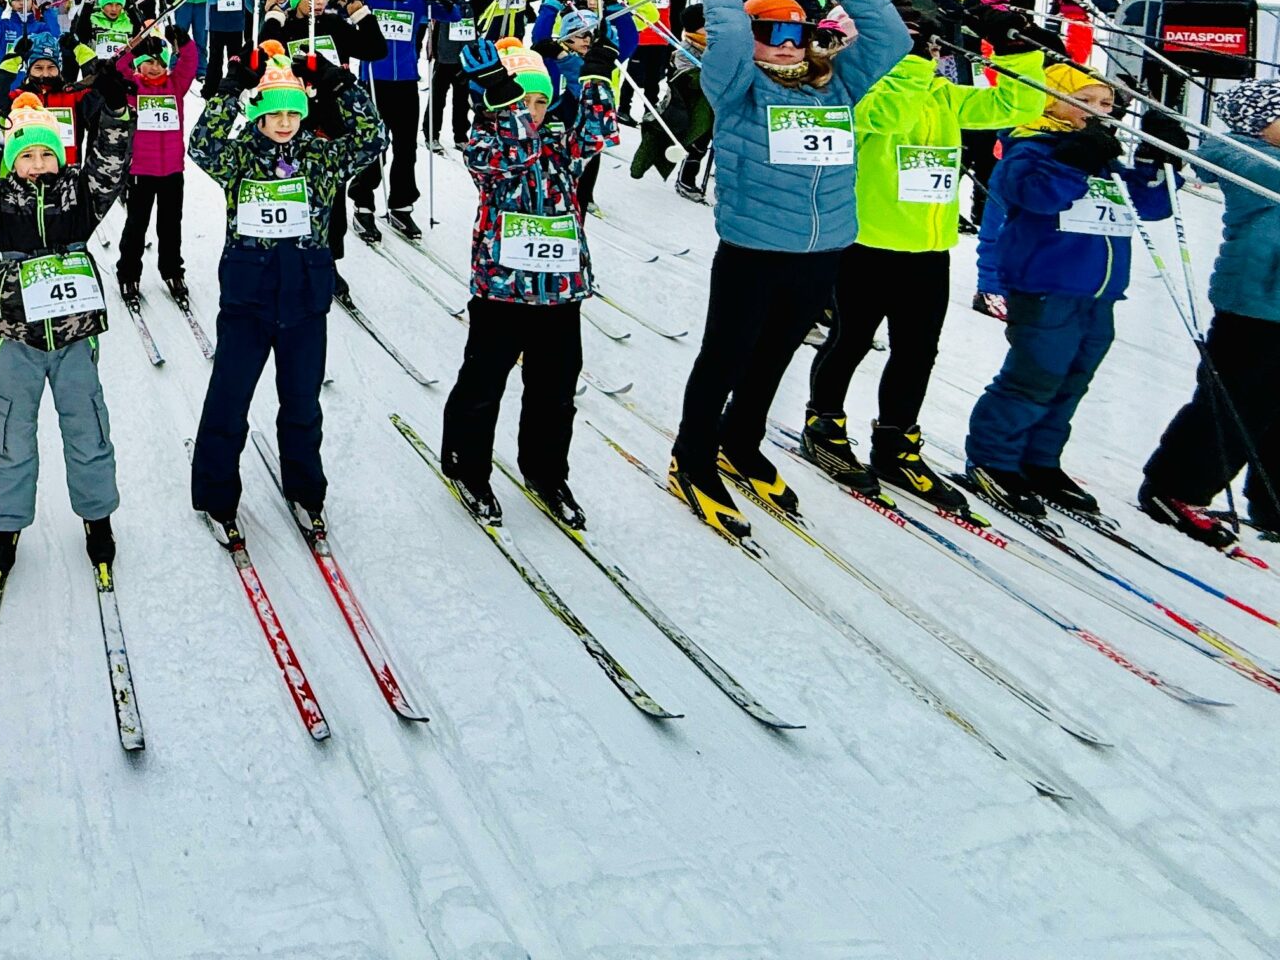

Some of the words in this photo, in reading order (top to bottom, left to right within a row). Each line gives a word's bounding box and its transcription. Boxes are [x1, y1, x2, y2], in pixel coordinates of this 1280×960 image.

[383, 24, 404, 33] 114
[1165, 31, 1244, 43] DATASPORT
[154, 112, 169, 122] 16
[803, 134, 833, 152] 31
[930, 173, 952, 189] 76
[261, 208, 288, 225] 50
[523, 242, 565, 259] 129
[50, 281, 78, 301] 45
[849, 489, 908, 529] SPORTEN
[1034, 492, 1097, 531] ALOMON
[935, 505, 1009, 550] SPORTEN
